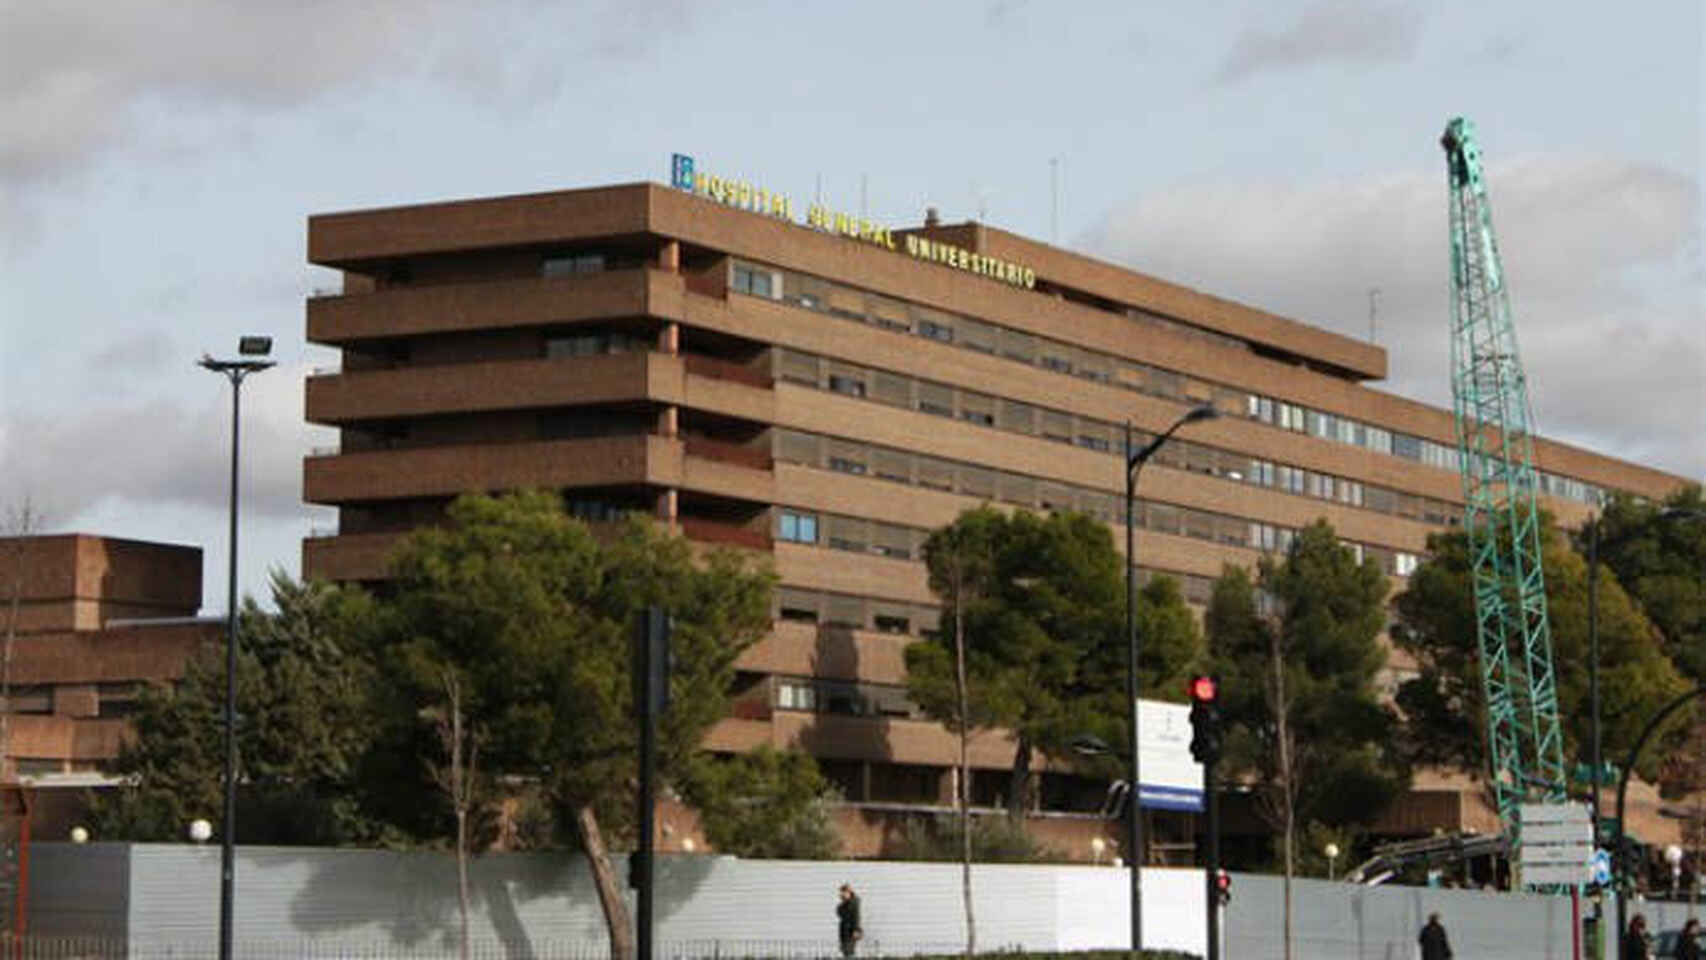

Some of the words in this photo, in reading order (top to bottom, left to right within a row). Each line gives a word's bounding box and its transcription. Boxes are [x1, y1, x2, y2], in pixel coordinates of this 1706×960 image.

[695, 172, 795, 220] HOSPITAL
[807, 203, 896, 251] GENERAL
[906, 235, 1036, 289] UNIVERSITARIO
